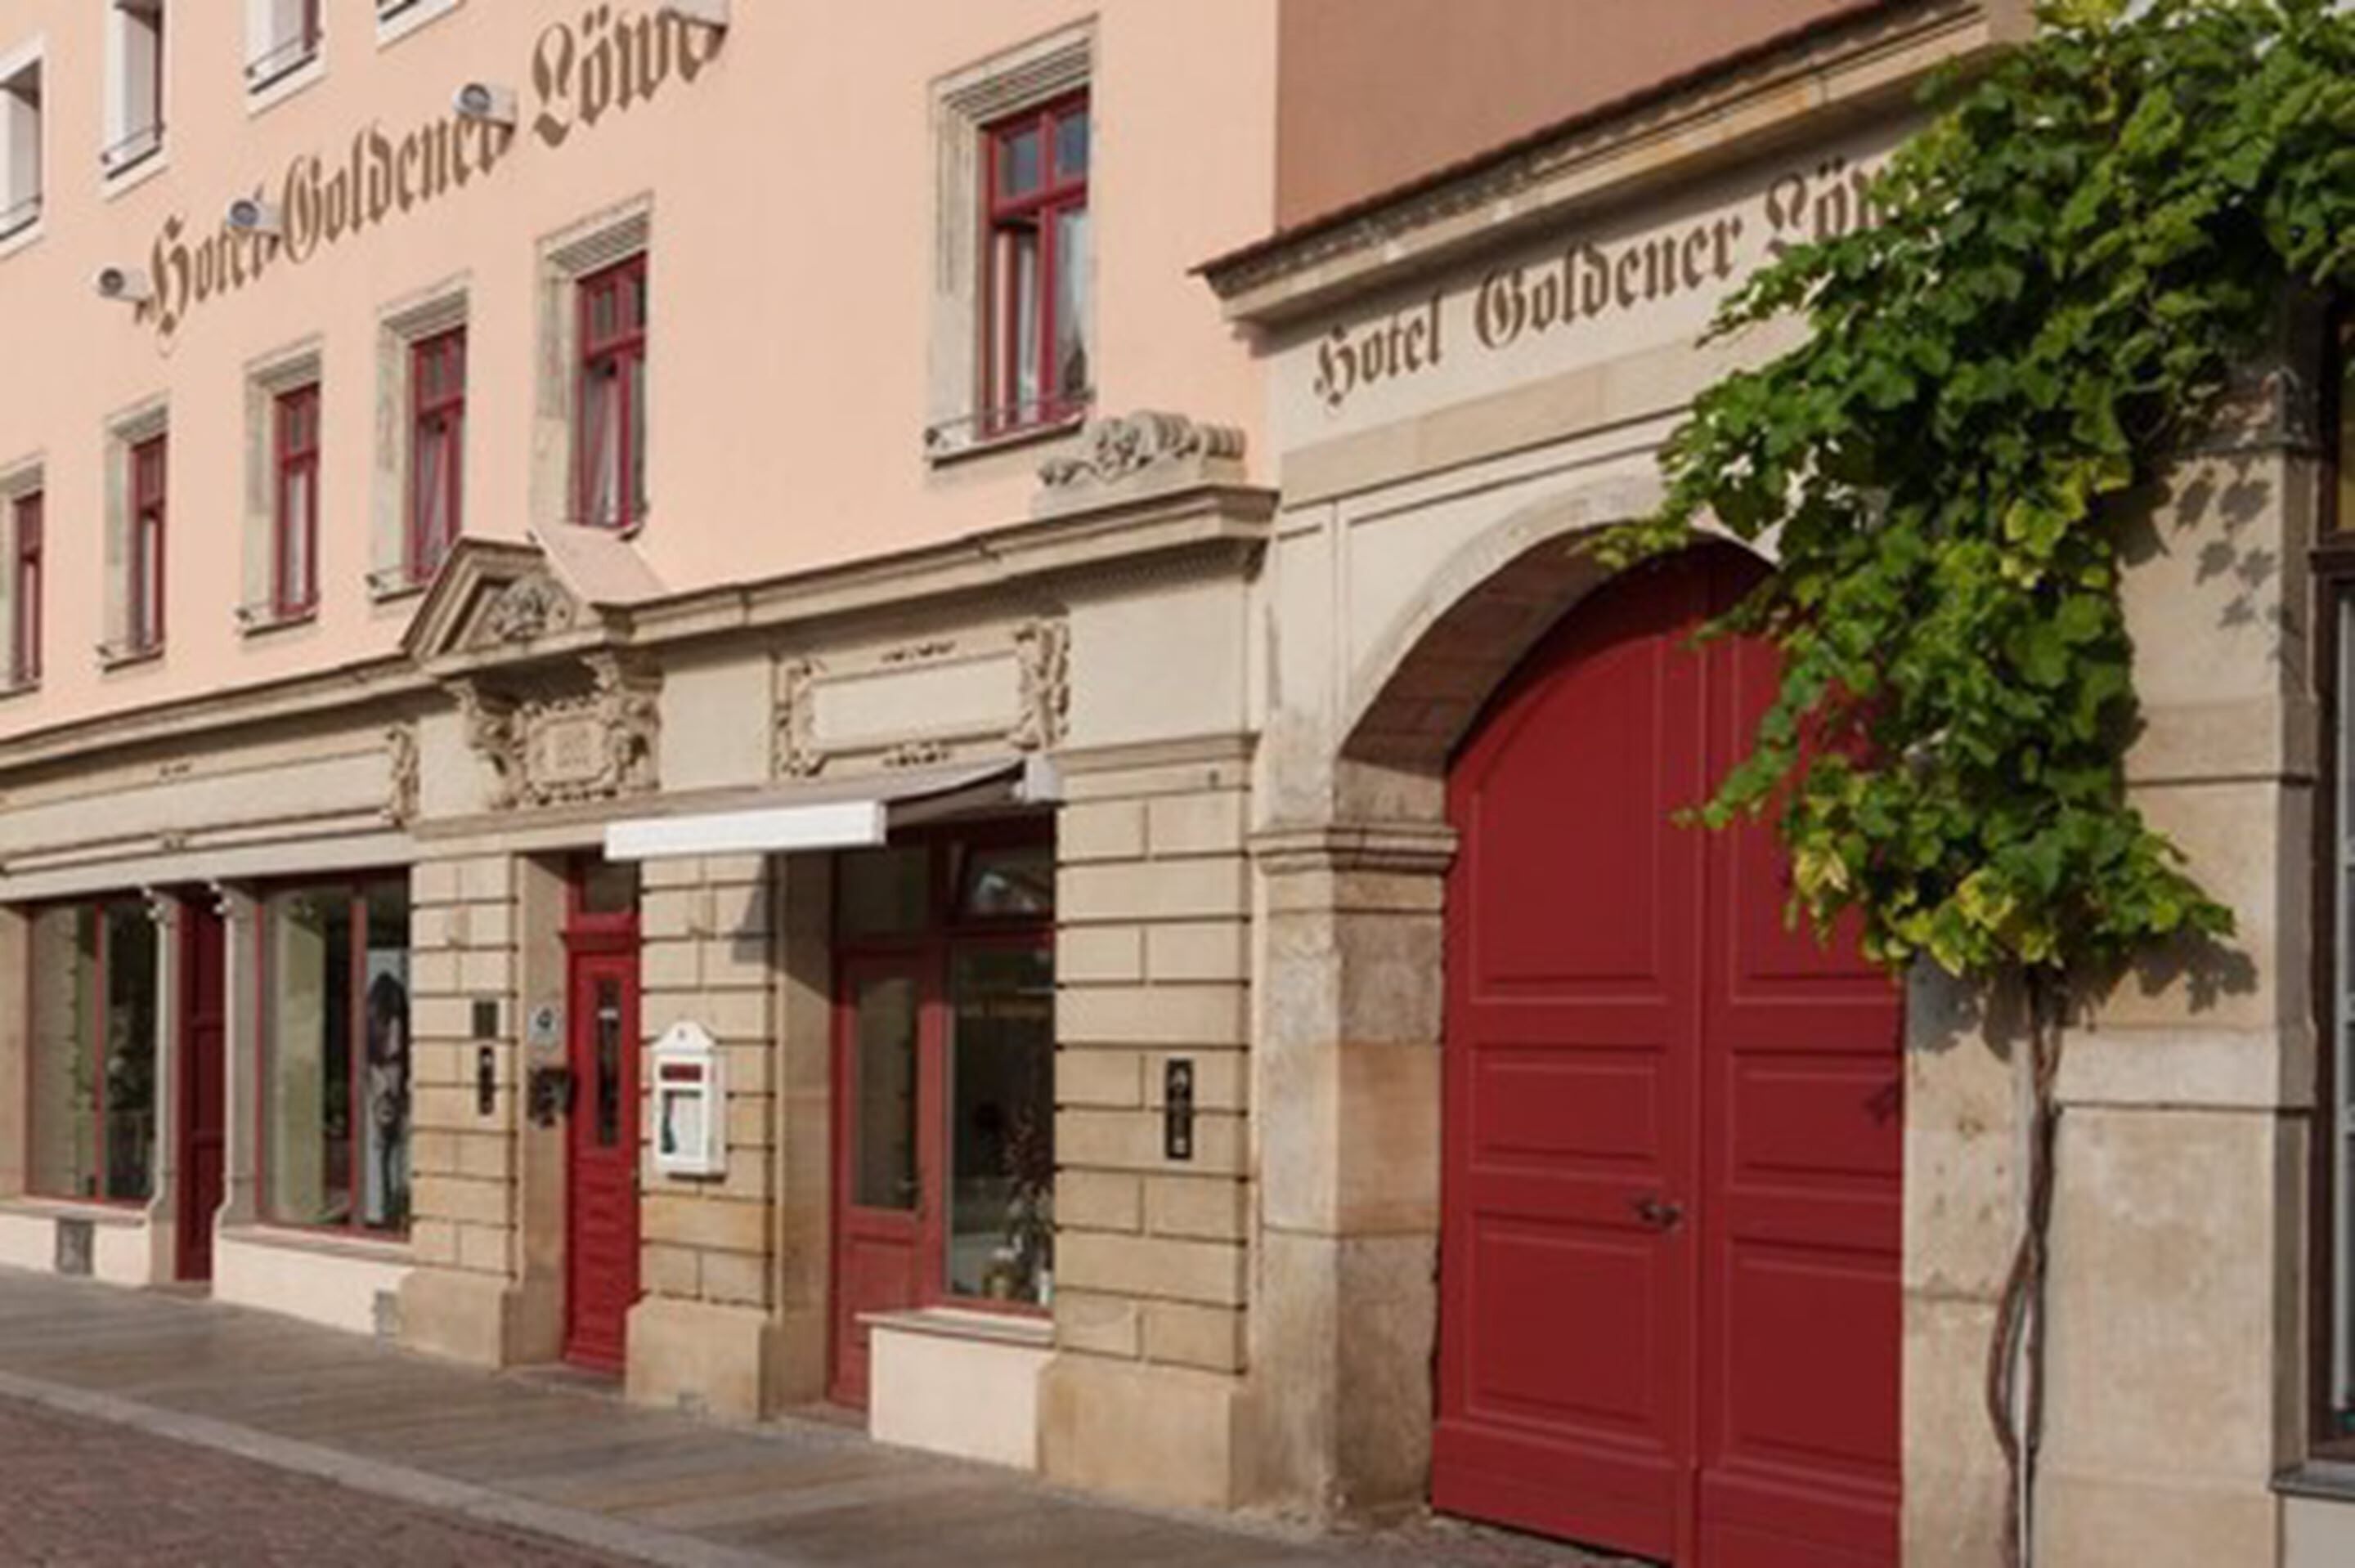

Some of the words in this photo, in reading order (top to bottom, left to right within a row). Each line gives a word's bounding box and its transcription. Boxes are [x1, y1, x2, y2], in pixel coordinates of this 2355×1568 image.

[146, 181, 265, 340] Hotel
[1313, 289, 1442, 409] Hotel
[1474, 214, 1743, 350] Goldener
